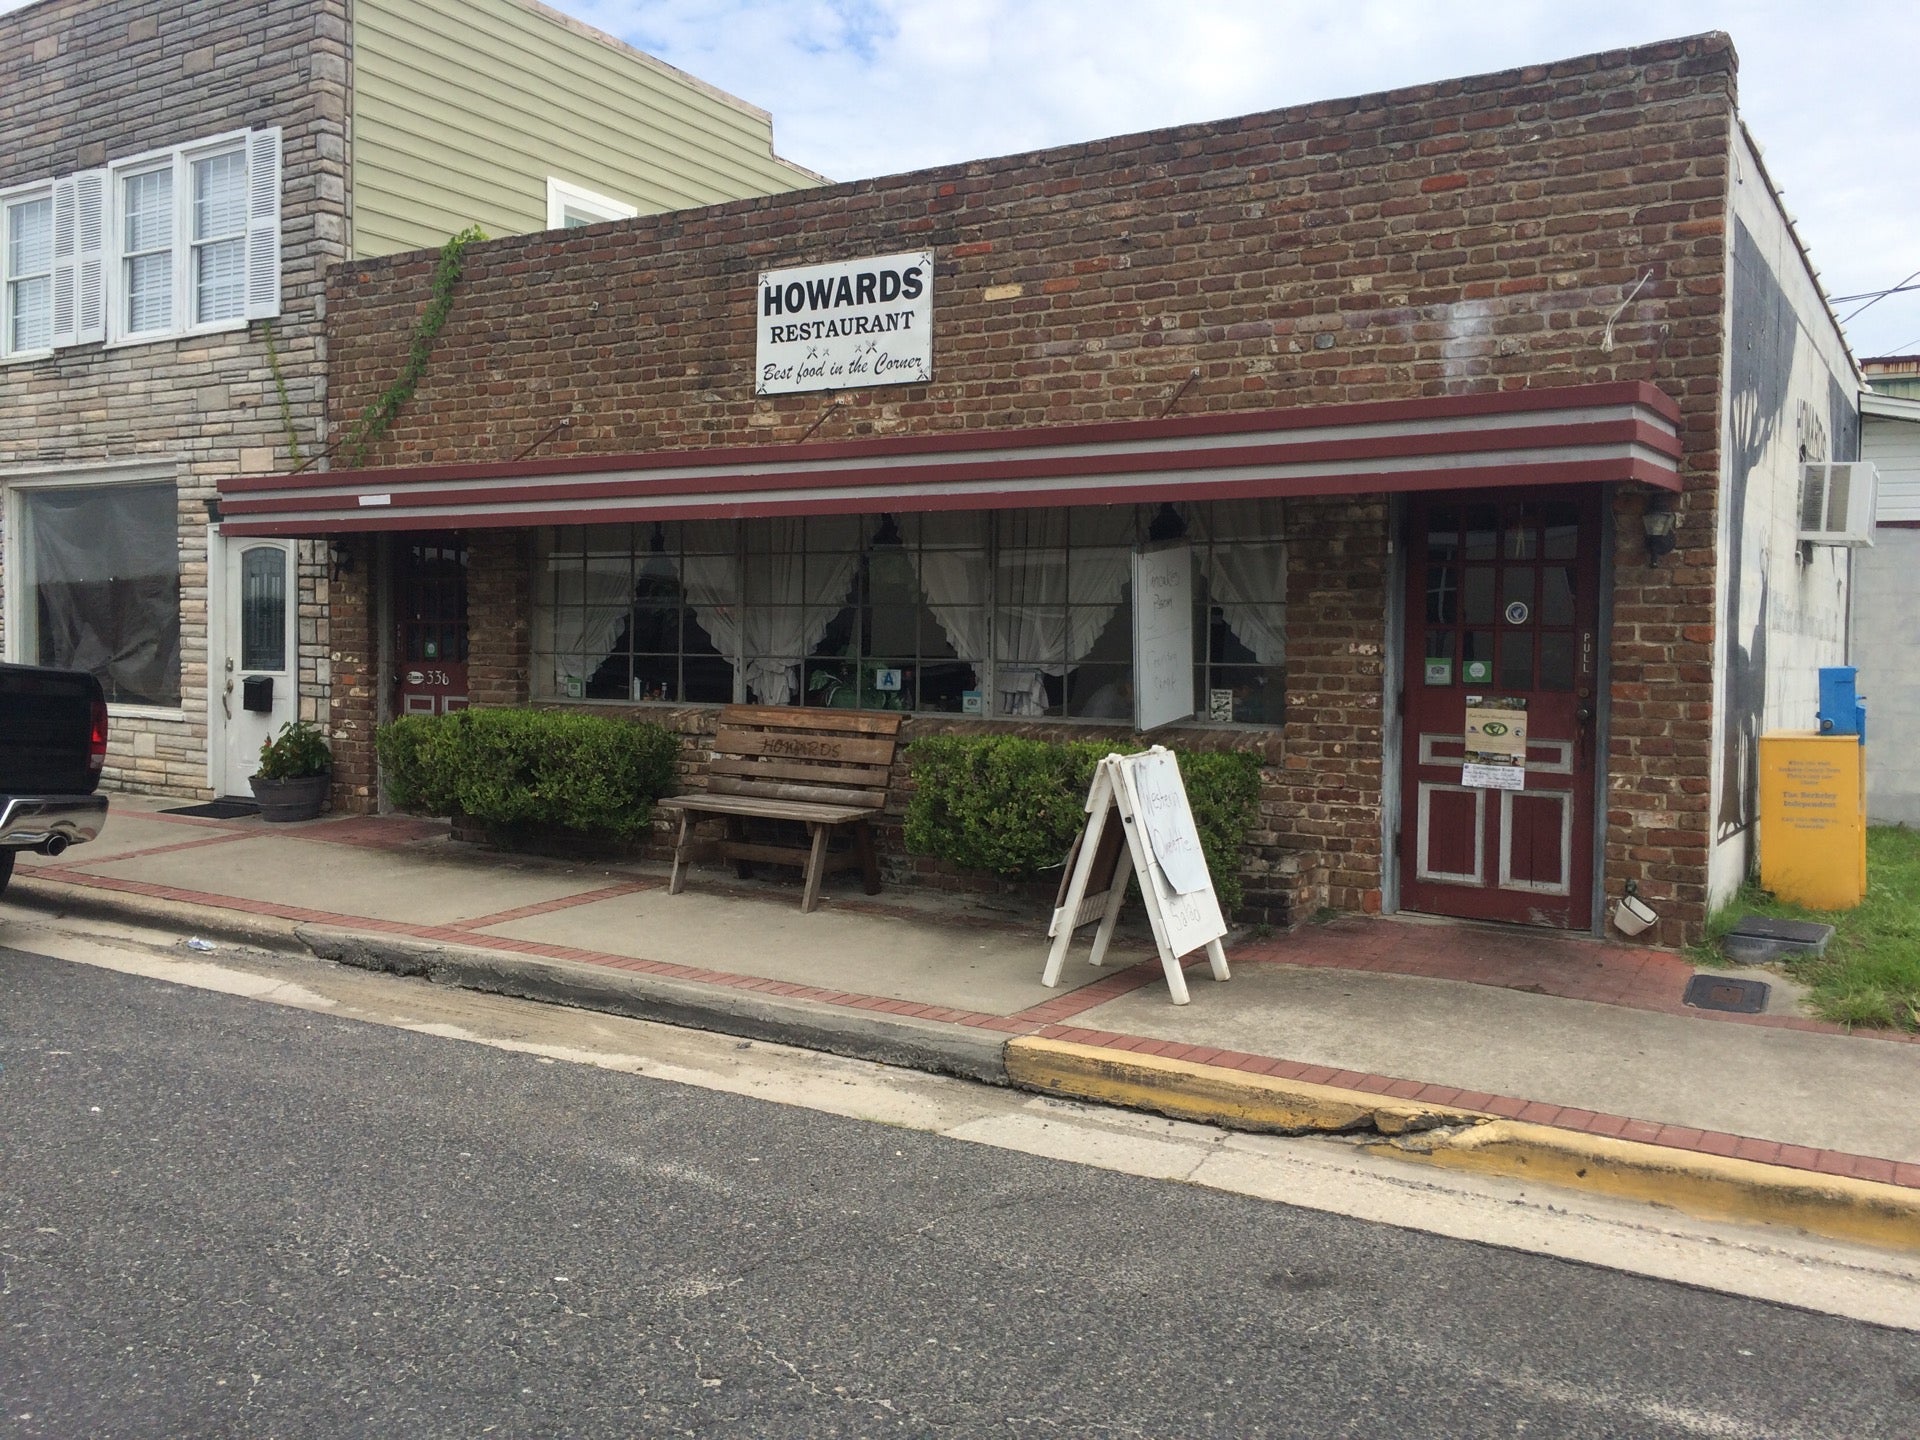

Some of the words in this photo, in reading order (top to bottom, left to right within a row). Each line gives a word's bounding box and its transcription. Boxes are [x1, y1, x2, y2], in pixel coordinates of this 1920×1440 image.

[764, 267, 923, 316] HOWARDS
[770, 310, 915, 344] RESTAURANT
[763, 362, 793, 381] Best
[796, 361, 826, 385] food
[830, 363, 844, 376] in
[848, 355, 868, 374] the
[874, 352, 922, 376] Corner
[426, 670, 450, 686] 336
[883, 672, 894, 686] A
[760, 737, 842, 758] HOWARDS
